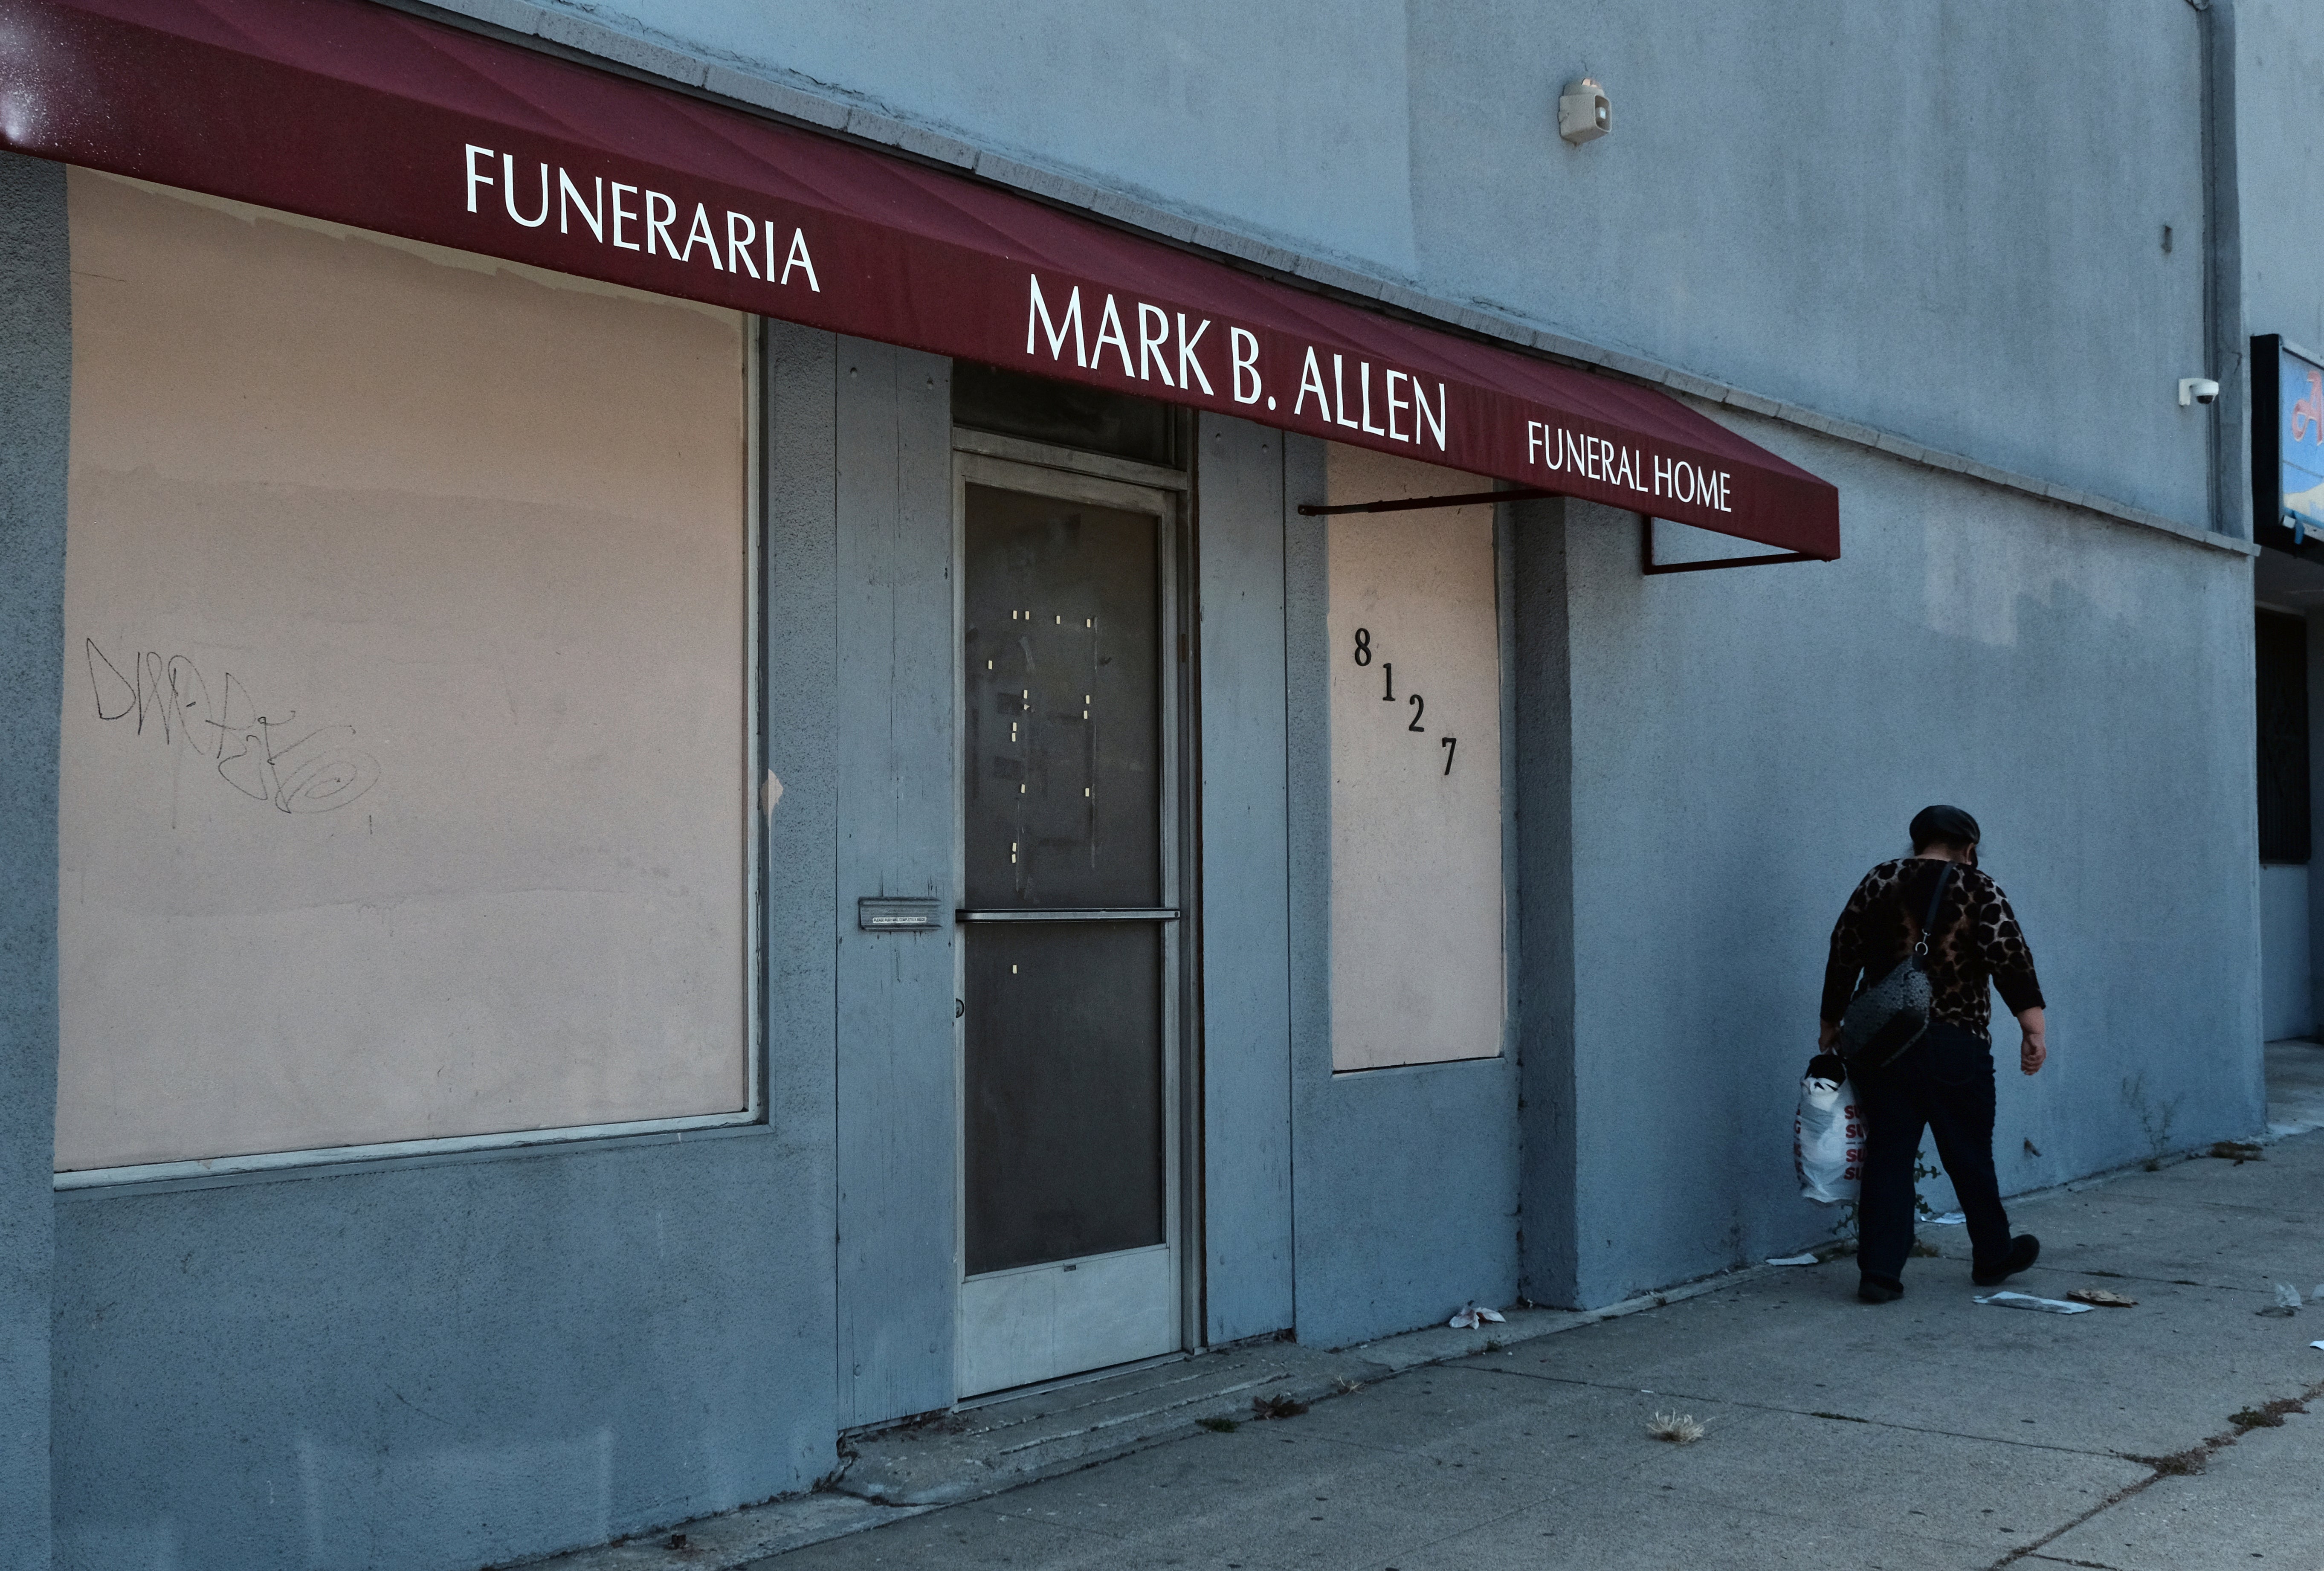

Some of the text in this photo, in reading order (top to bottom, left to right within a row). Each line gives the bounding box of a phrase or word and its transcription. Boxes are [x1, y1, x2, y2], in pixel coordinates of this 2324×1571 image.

[465, 143, 820, 293] FUNERARIA
[1027, 274, 1446, 452] MARK B. ALLEN
[1528, 420, 1731, 512] FUNERAL HOME
